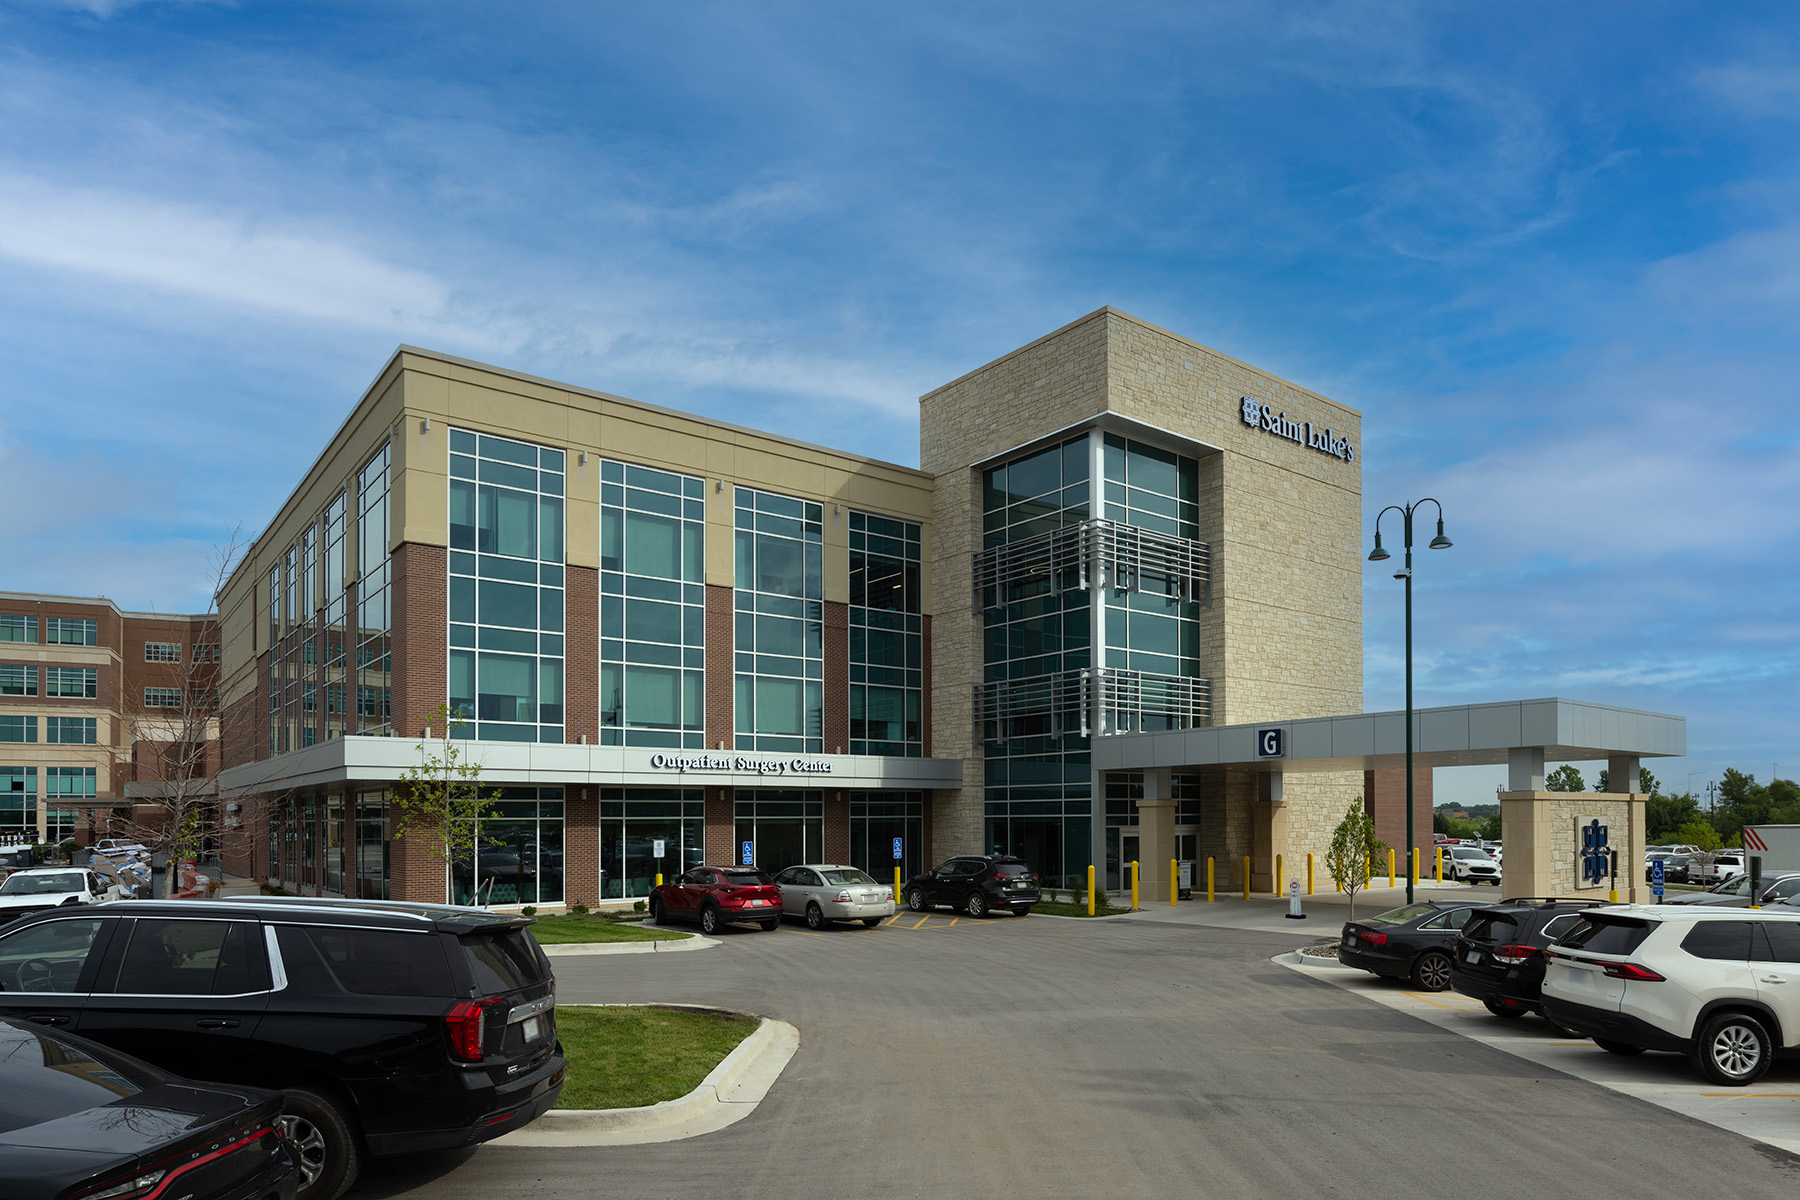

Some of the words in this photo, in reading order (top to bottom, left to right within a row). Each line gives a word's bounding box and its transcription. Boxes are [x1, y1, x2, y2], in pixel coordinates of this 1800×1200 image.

[1261, 404, 1305, 444] Saint
[1306, 422, 1355, 462] Luke's
[1264, 731, 1277, 754] G
[651, 753, 731, 773] Outpatient
[734, 756, 788, 776] Surgery
[792, 758, 833, 773] Center
[191, 1123, 262, 1159] DODGE
